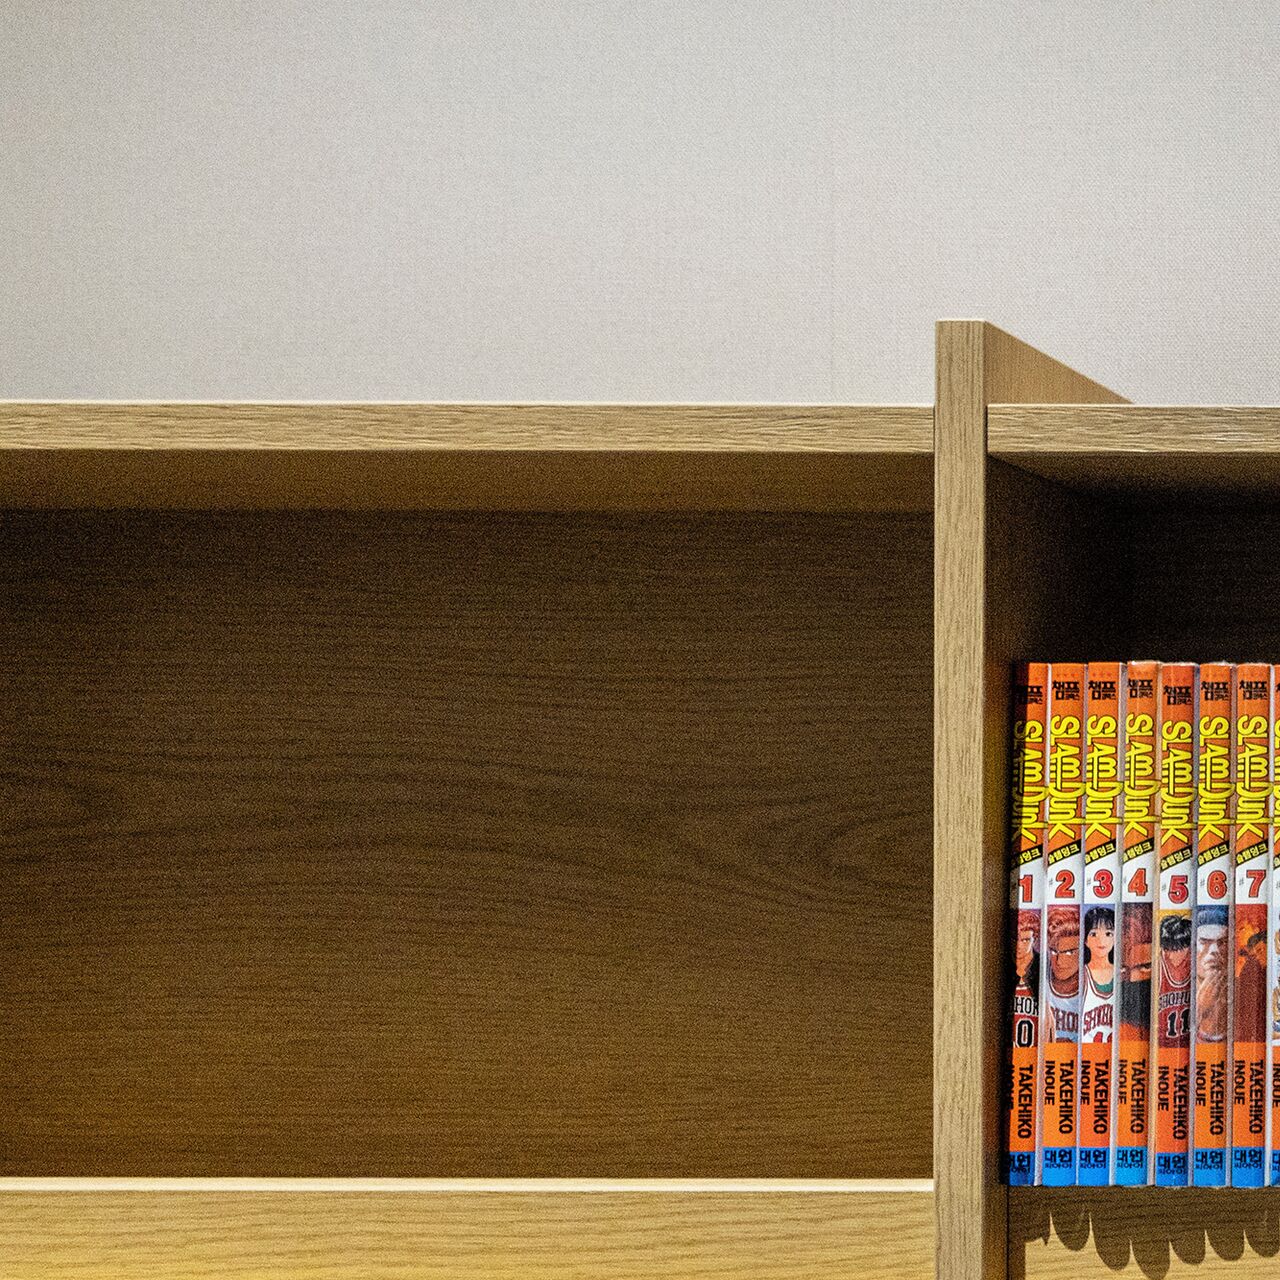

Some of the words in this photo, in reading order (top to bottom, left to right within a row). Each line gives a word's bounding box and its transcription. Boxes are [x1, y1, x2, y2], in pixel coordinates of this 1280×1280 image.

[1018, 875, 1033, 902] 1
[1055, 870, 1074, 898] 2
[1093, 869, 1113, 898] 3
[1128, 868, 1147, 896] 4
[1169, 875, 1188, 904] 5
[1207, 871, 1227, 899] 6
[1247, 869, 1265, 897] 7
[1018, 1064, 1033, 1138] TAKEHIKO
[1044, 1060, 1055, 1105] INOUE
[1059, 1060, 1074, 1134] TAKEHIKO
[1079, 1060, 1090, 1105] INOUE
[1094, 1060, 1109, 1134] TAKEHIKO
[1116, 1059, 1127, 1104] INOUE
[1131, 1059, 1146, 1133] TAKEHIKO
[1158, 1066, 1169, 1111] INOUE
[1173, 1066, 1188, 1140] TAKEHIKO
[1195, 1061, 1206, 1106] INOUE
[1210, 1061, 1225, 1135] TAKEHIKO
[1234, 1060, 1245, 1105] INOUE
[1249, 1060, 1264, 1134] TAKEHIKO
